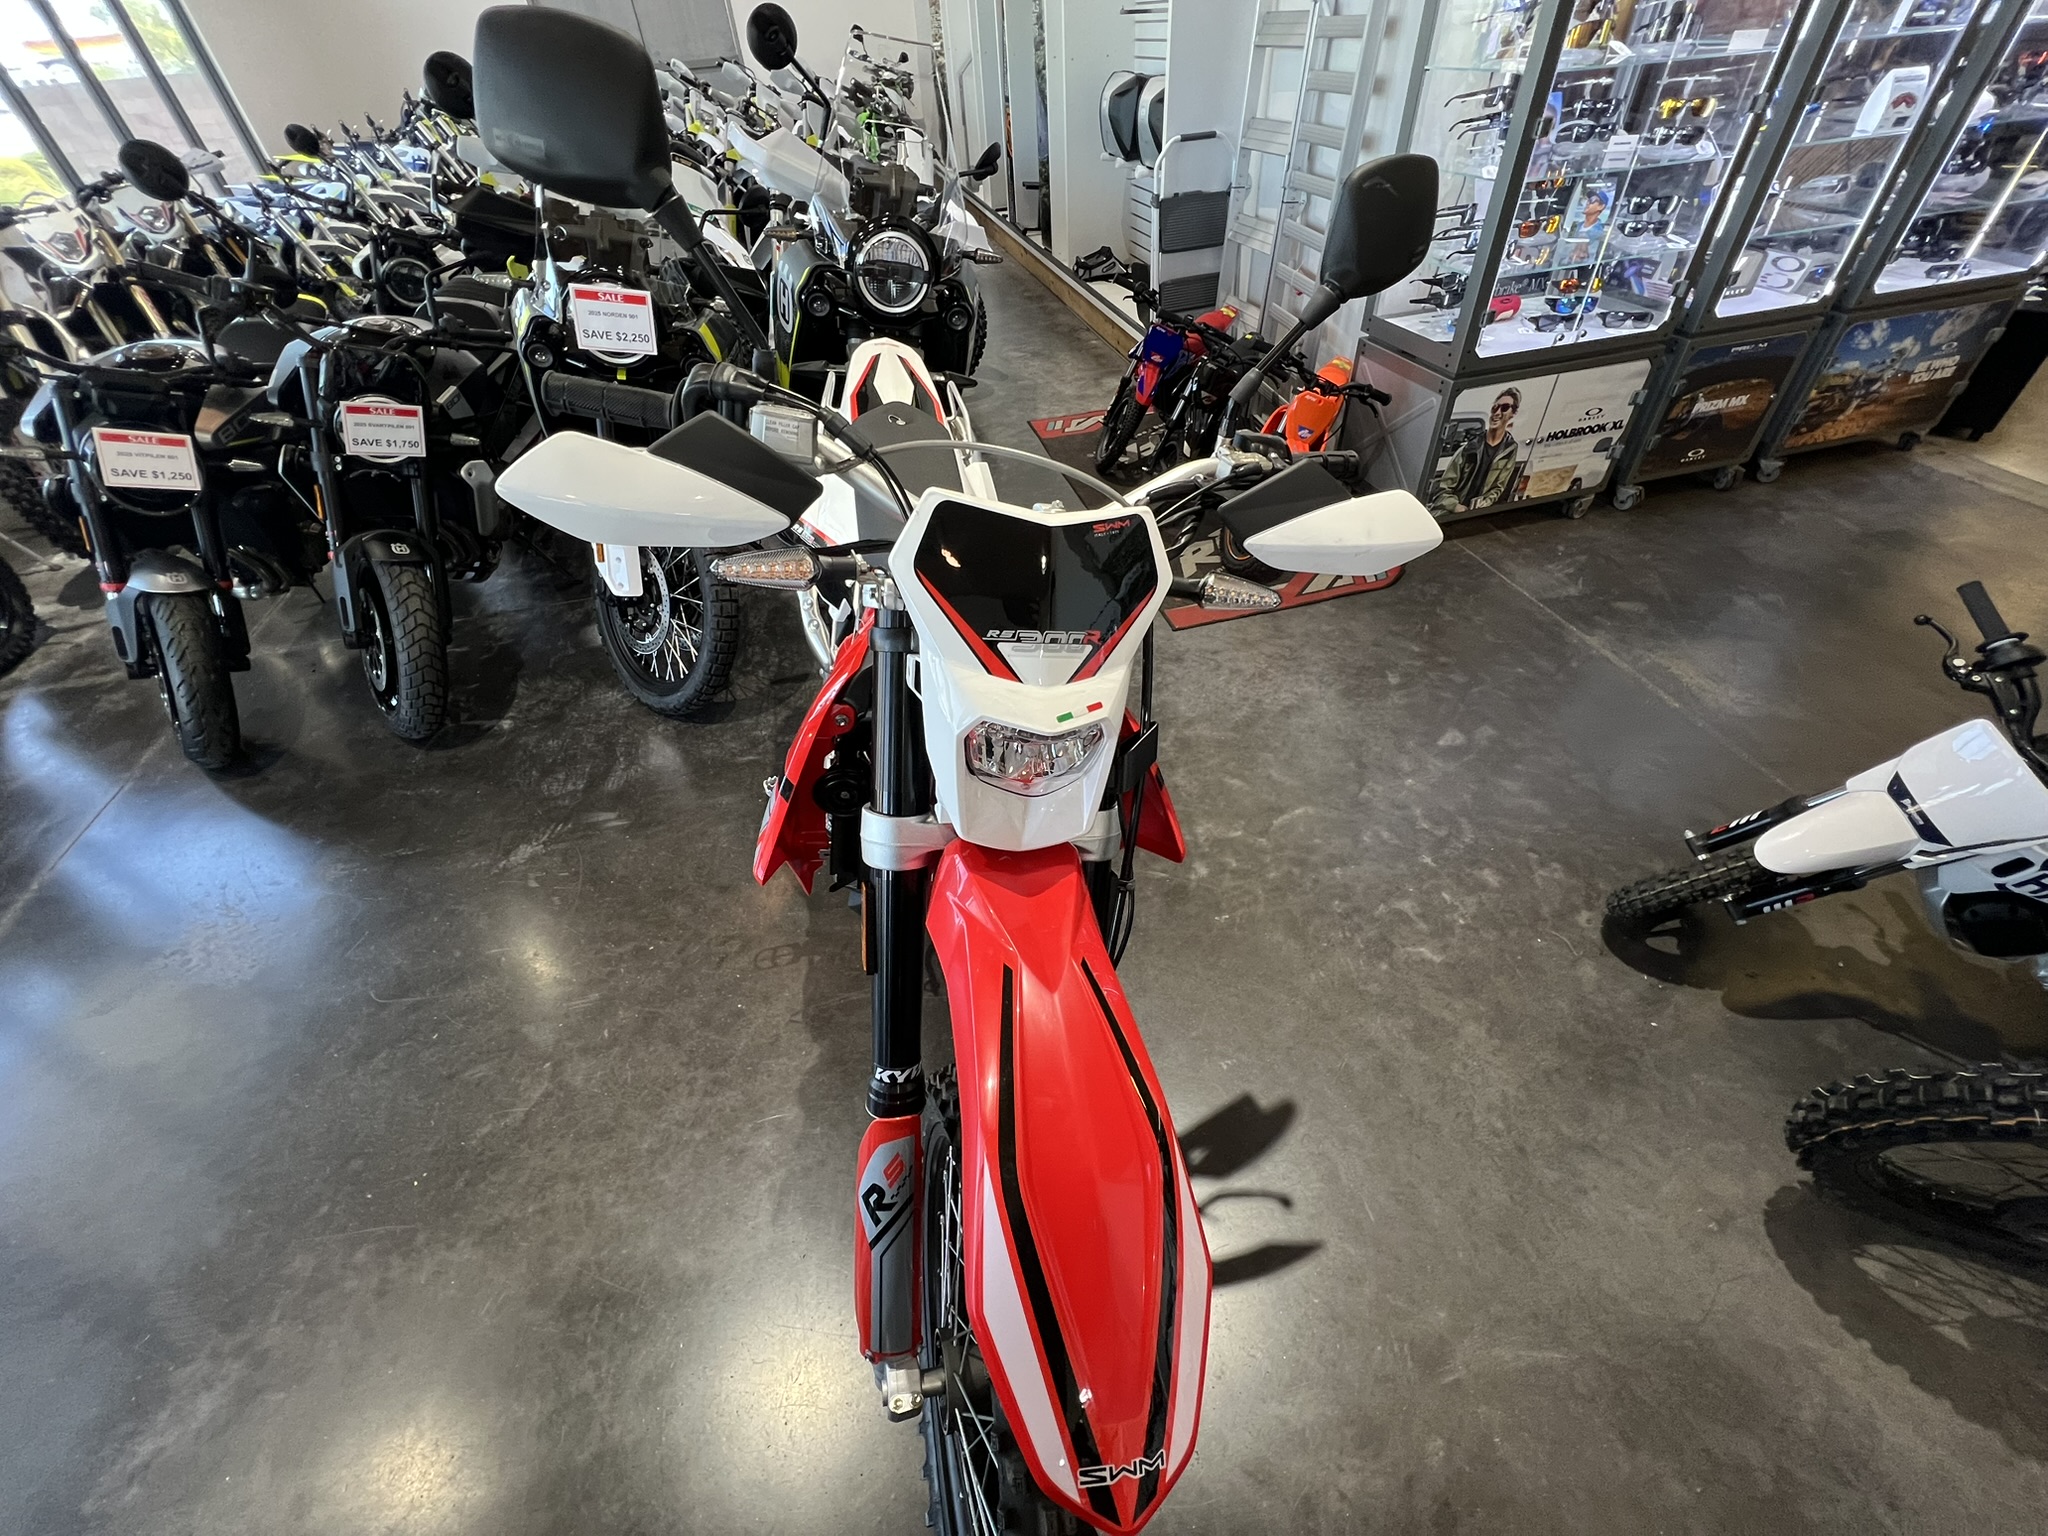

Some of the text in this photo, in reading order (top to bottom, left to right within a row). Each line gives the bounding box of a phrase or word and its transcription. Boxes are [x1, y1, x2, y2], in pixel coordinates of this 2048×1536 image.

[597, 292, 625, 303] SALE
[602, 311, 628, 319] NORDEN
[582, 328, 650, 344] SAVE $2,250
[1913, 354, 1961, 375] BE WHO
[1908, 366, 1957, 385] YOU ARE
[1690, 394, 1751, 414] PRIZM MX
[368, 407, 396, 416] SALE
[1545, 419, 1625, 442] HOLBROOK XL
[128, 435, 160, 445] SALE
[352, 437, 420, 449] SAVE $1,750
[110, 467, 193, 481] SAVE $1,250
[1092, 519, 1130, 533] SWM
[1078, 1449, 1166, 1489] SWM
